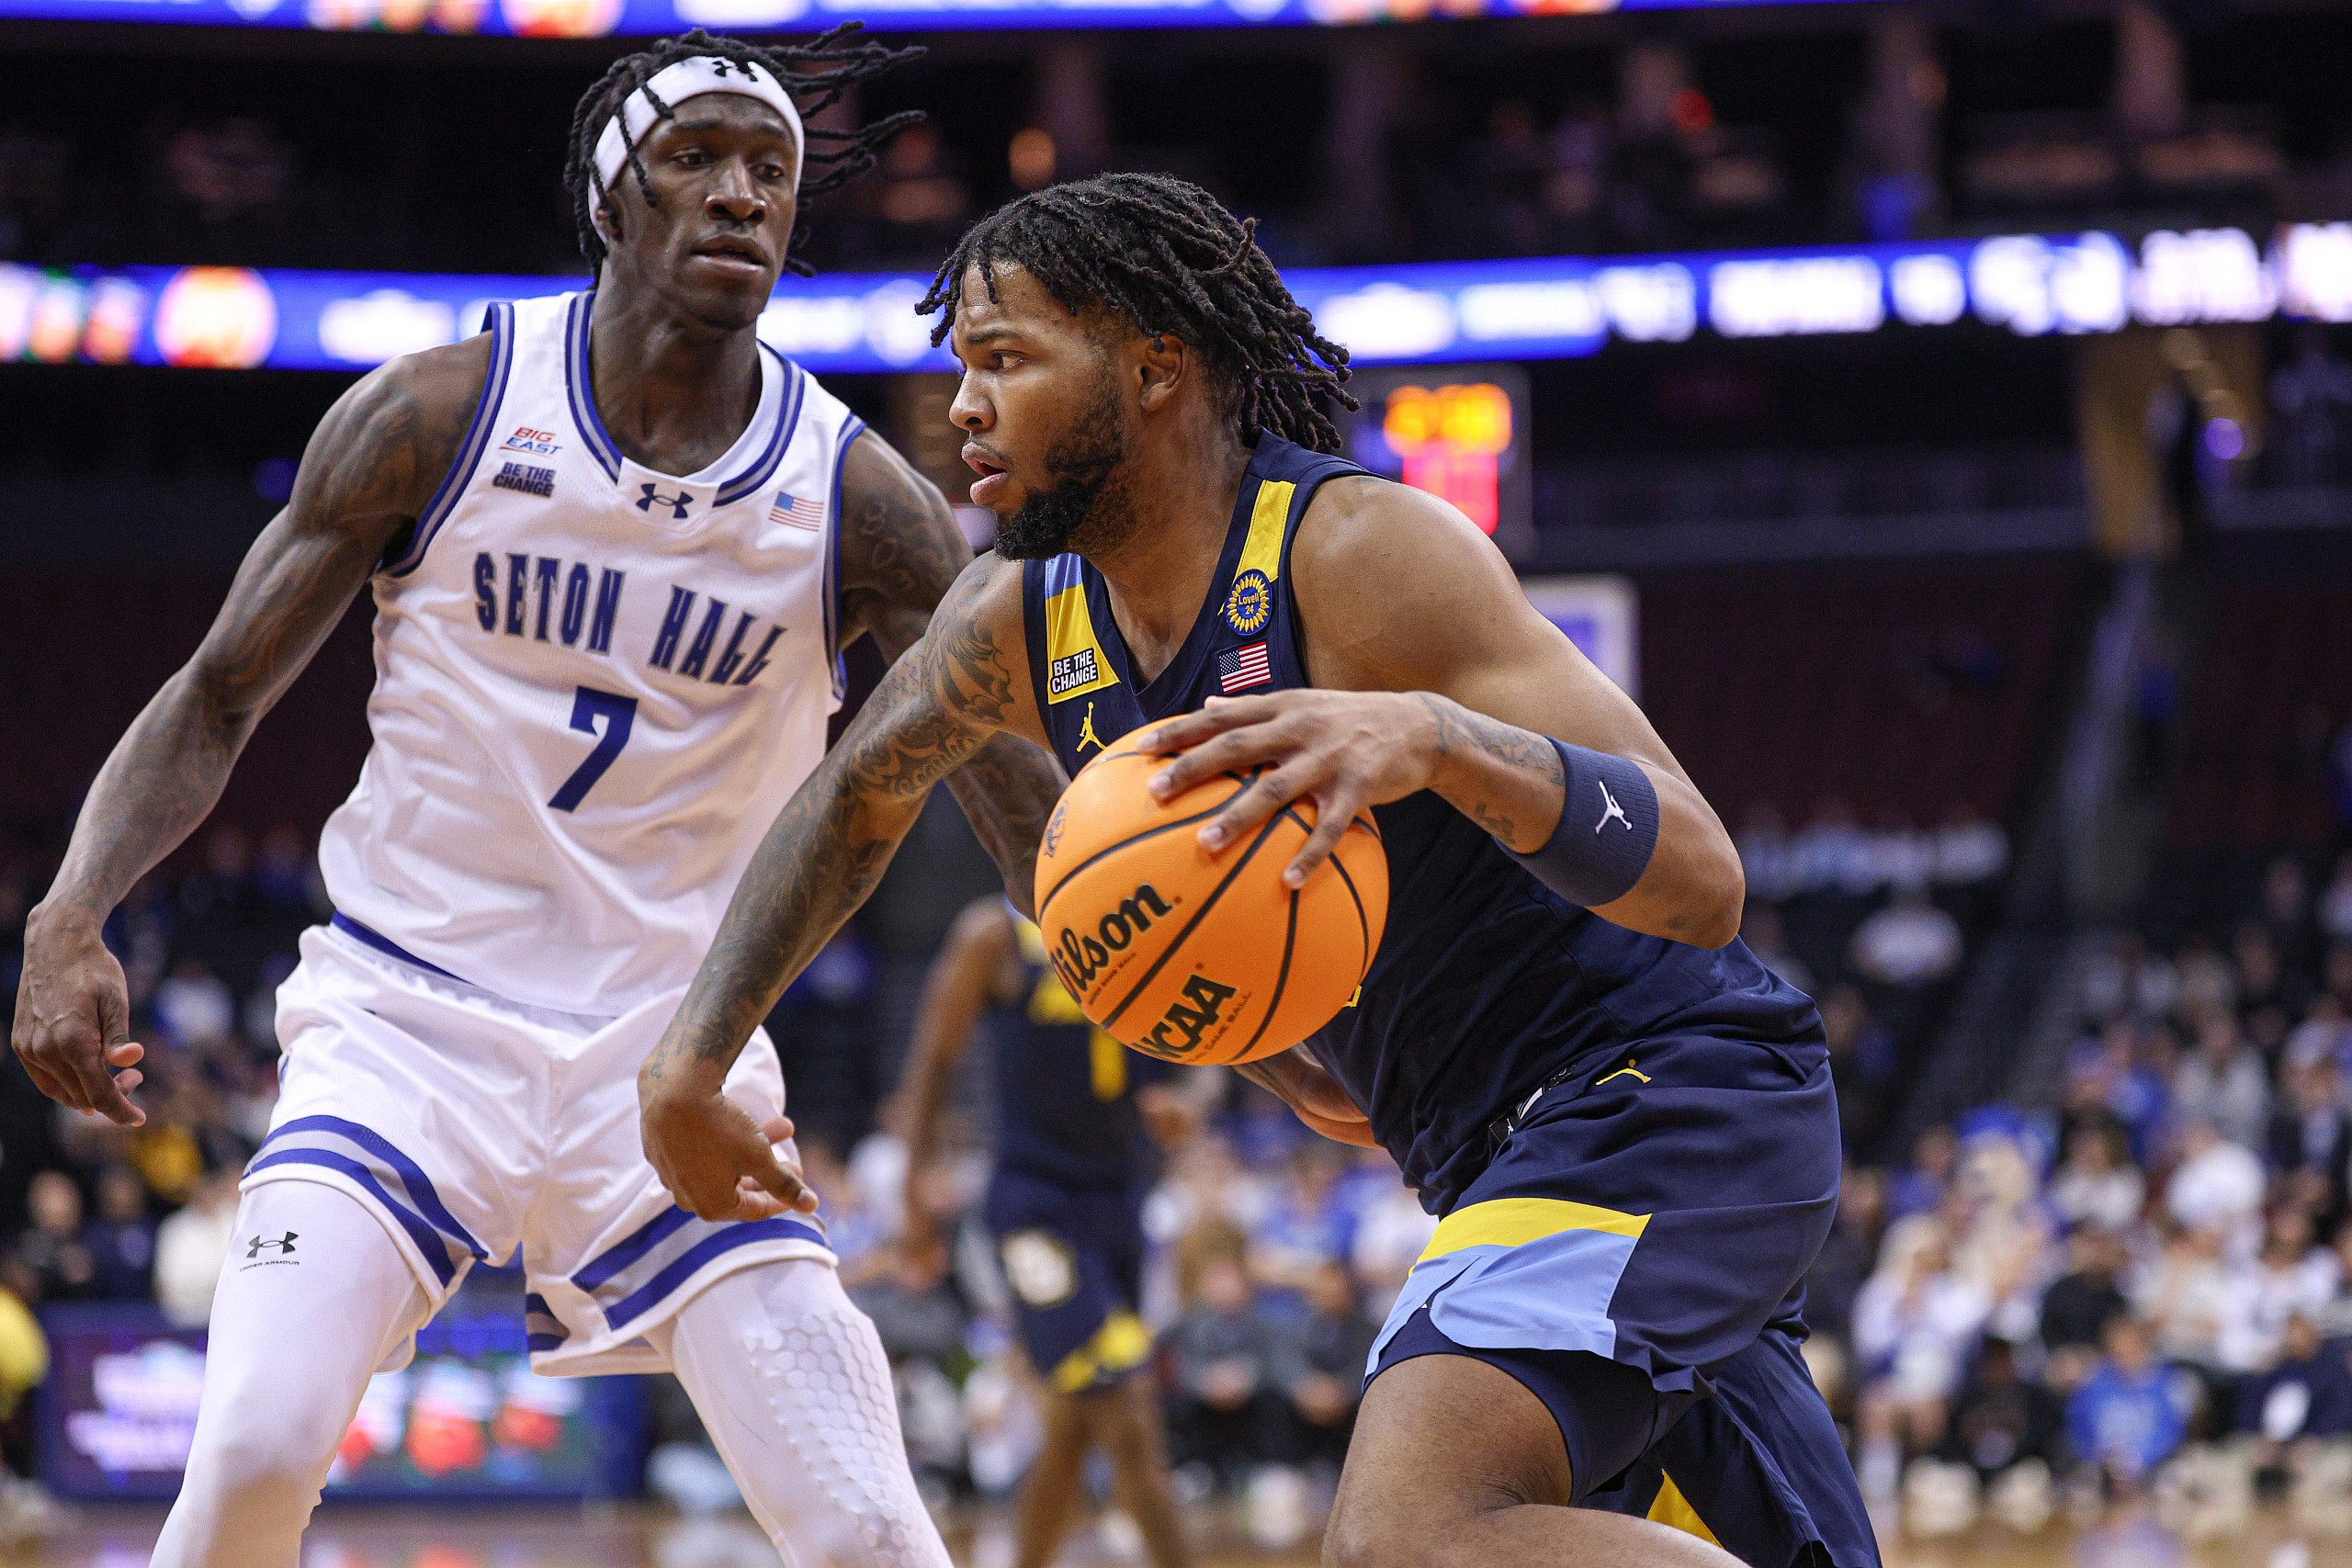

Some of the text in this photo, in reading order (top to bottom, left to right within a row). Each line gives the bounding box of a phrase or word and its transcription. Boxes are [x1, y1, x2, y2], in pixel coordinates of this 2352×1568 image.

[505, 436, 563, 455] EAST
[514, 427, 556, 443] BIG
[501, 462, 557, 484] BE THE
[492, 474, 555, 498] CHANGE
[1238, 592, 1260, 606] Lovell
[1245, 604, 1255, 615] 24
[473, 552, 787, 685] SETON HALL
[1053, 649, 1093, 677] BE THE
[1051, 663, 1097, 694] CHANGE
[548, 685, 638, 813] 7
